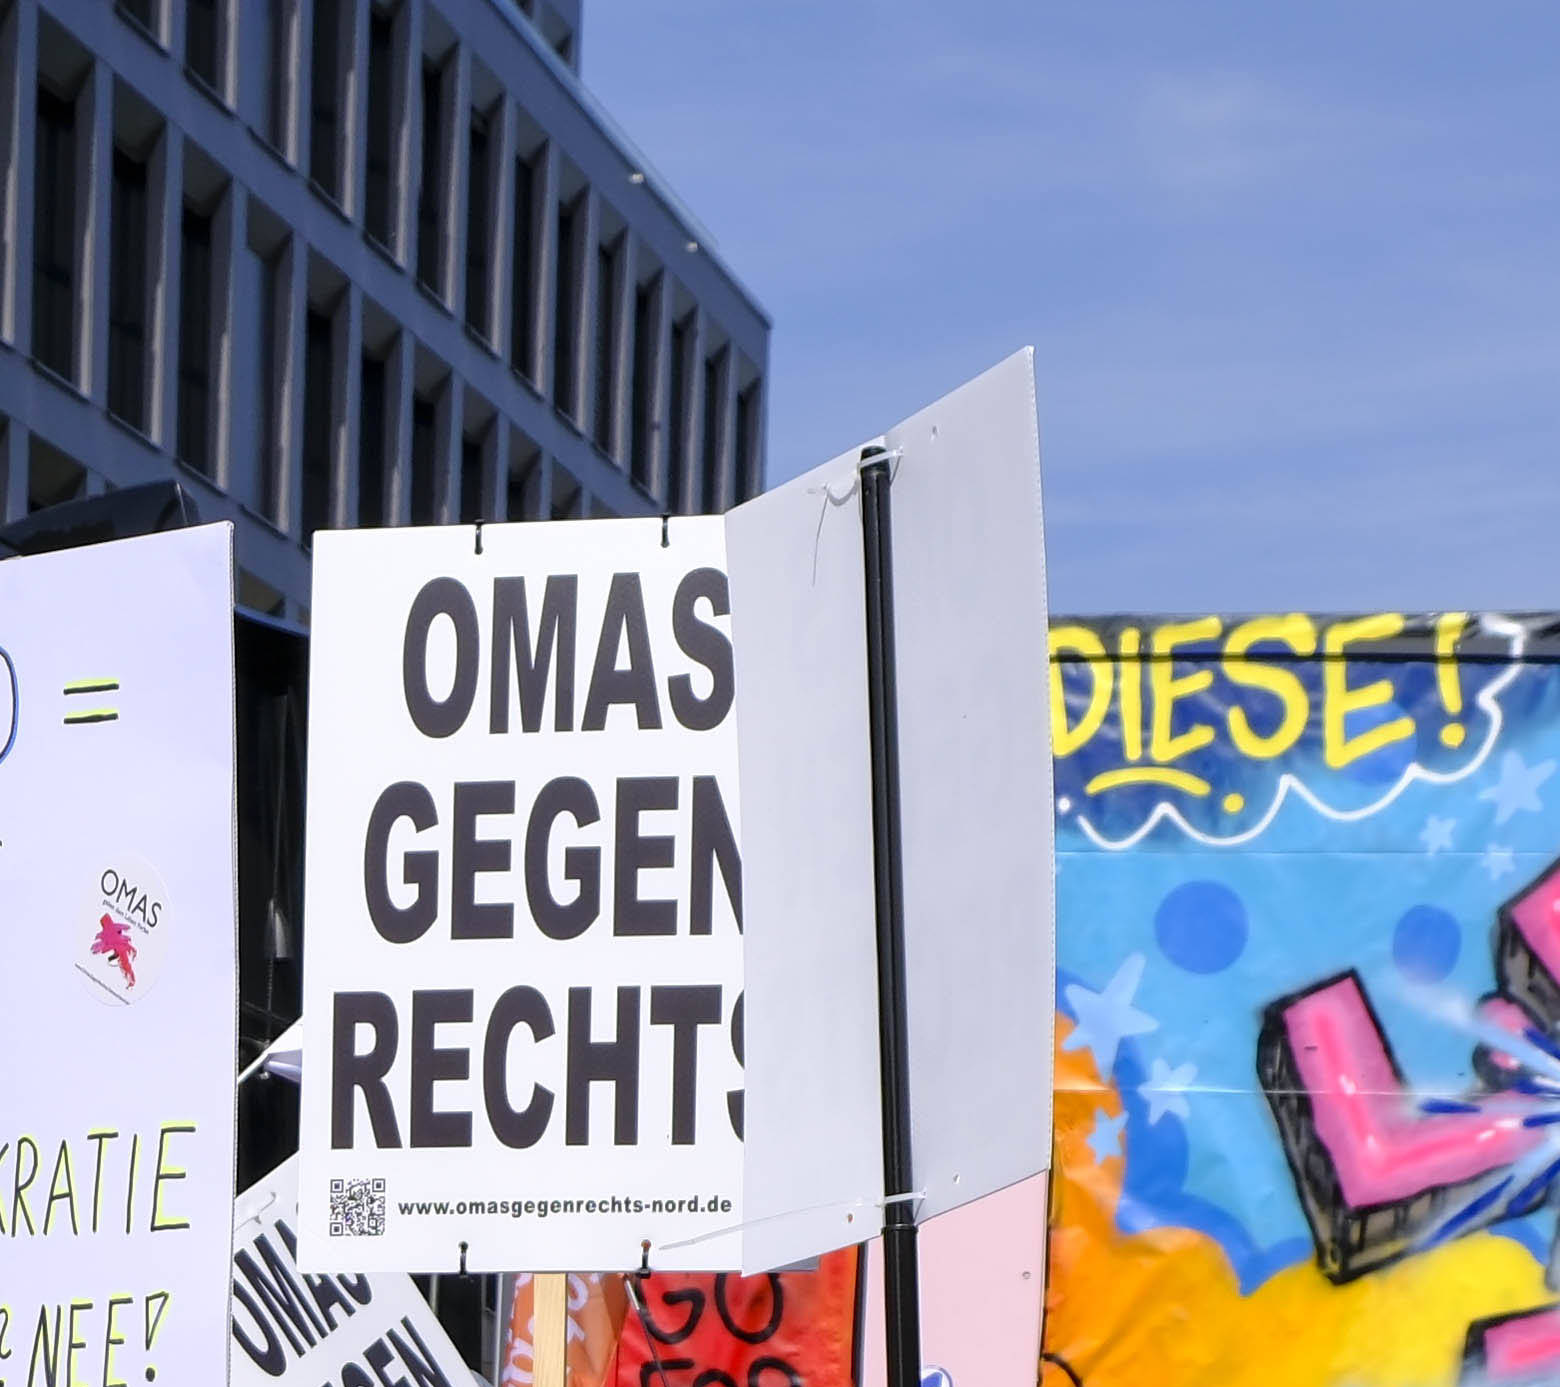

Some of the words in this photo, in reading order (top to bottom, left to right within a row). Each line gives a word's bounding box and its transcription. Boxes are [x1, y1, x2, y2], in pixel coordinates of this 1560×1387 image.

[401, 566, 736, 739] OMAS
[1049, 612, 1468, 770] DIESE!
[101, 869, 162, 928] OMAS
[363, 775, 744, 945] GEGEN
[329, 983, 746, 1151] RECHT
[396, 1194, 733, 1219] www.omasgegenrechts-nord.de
